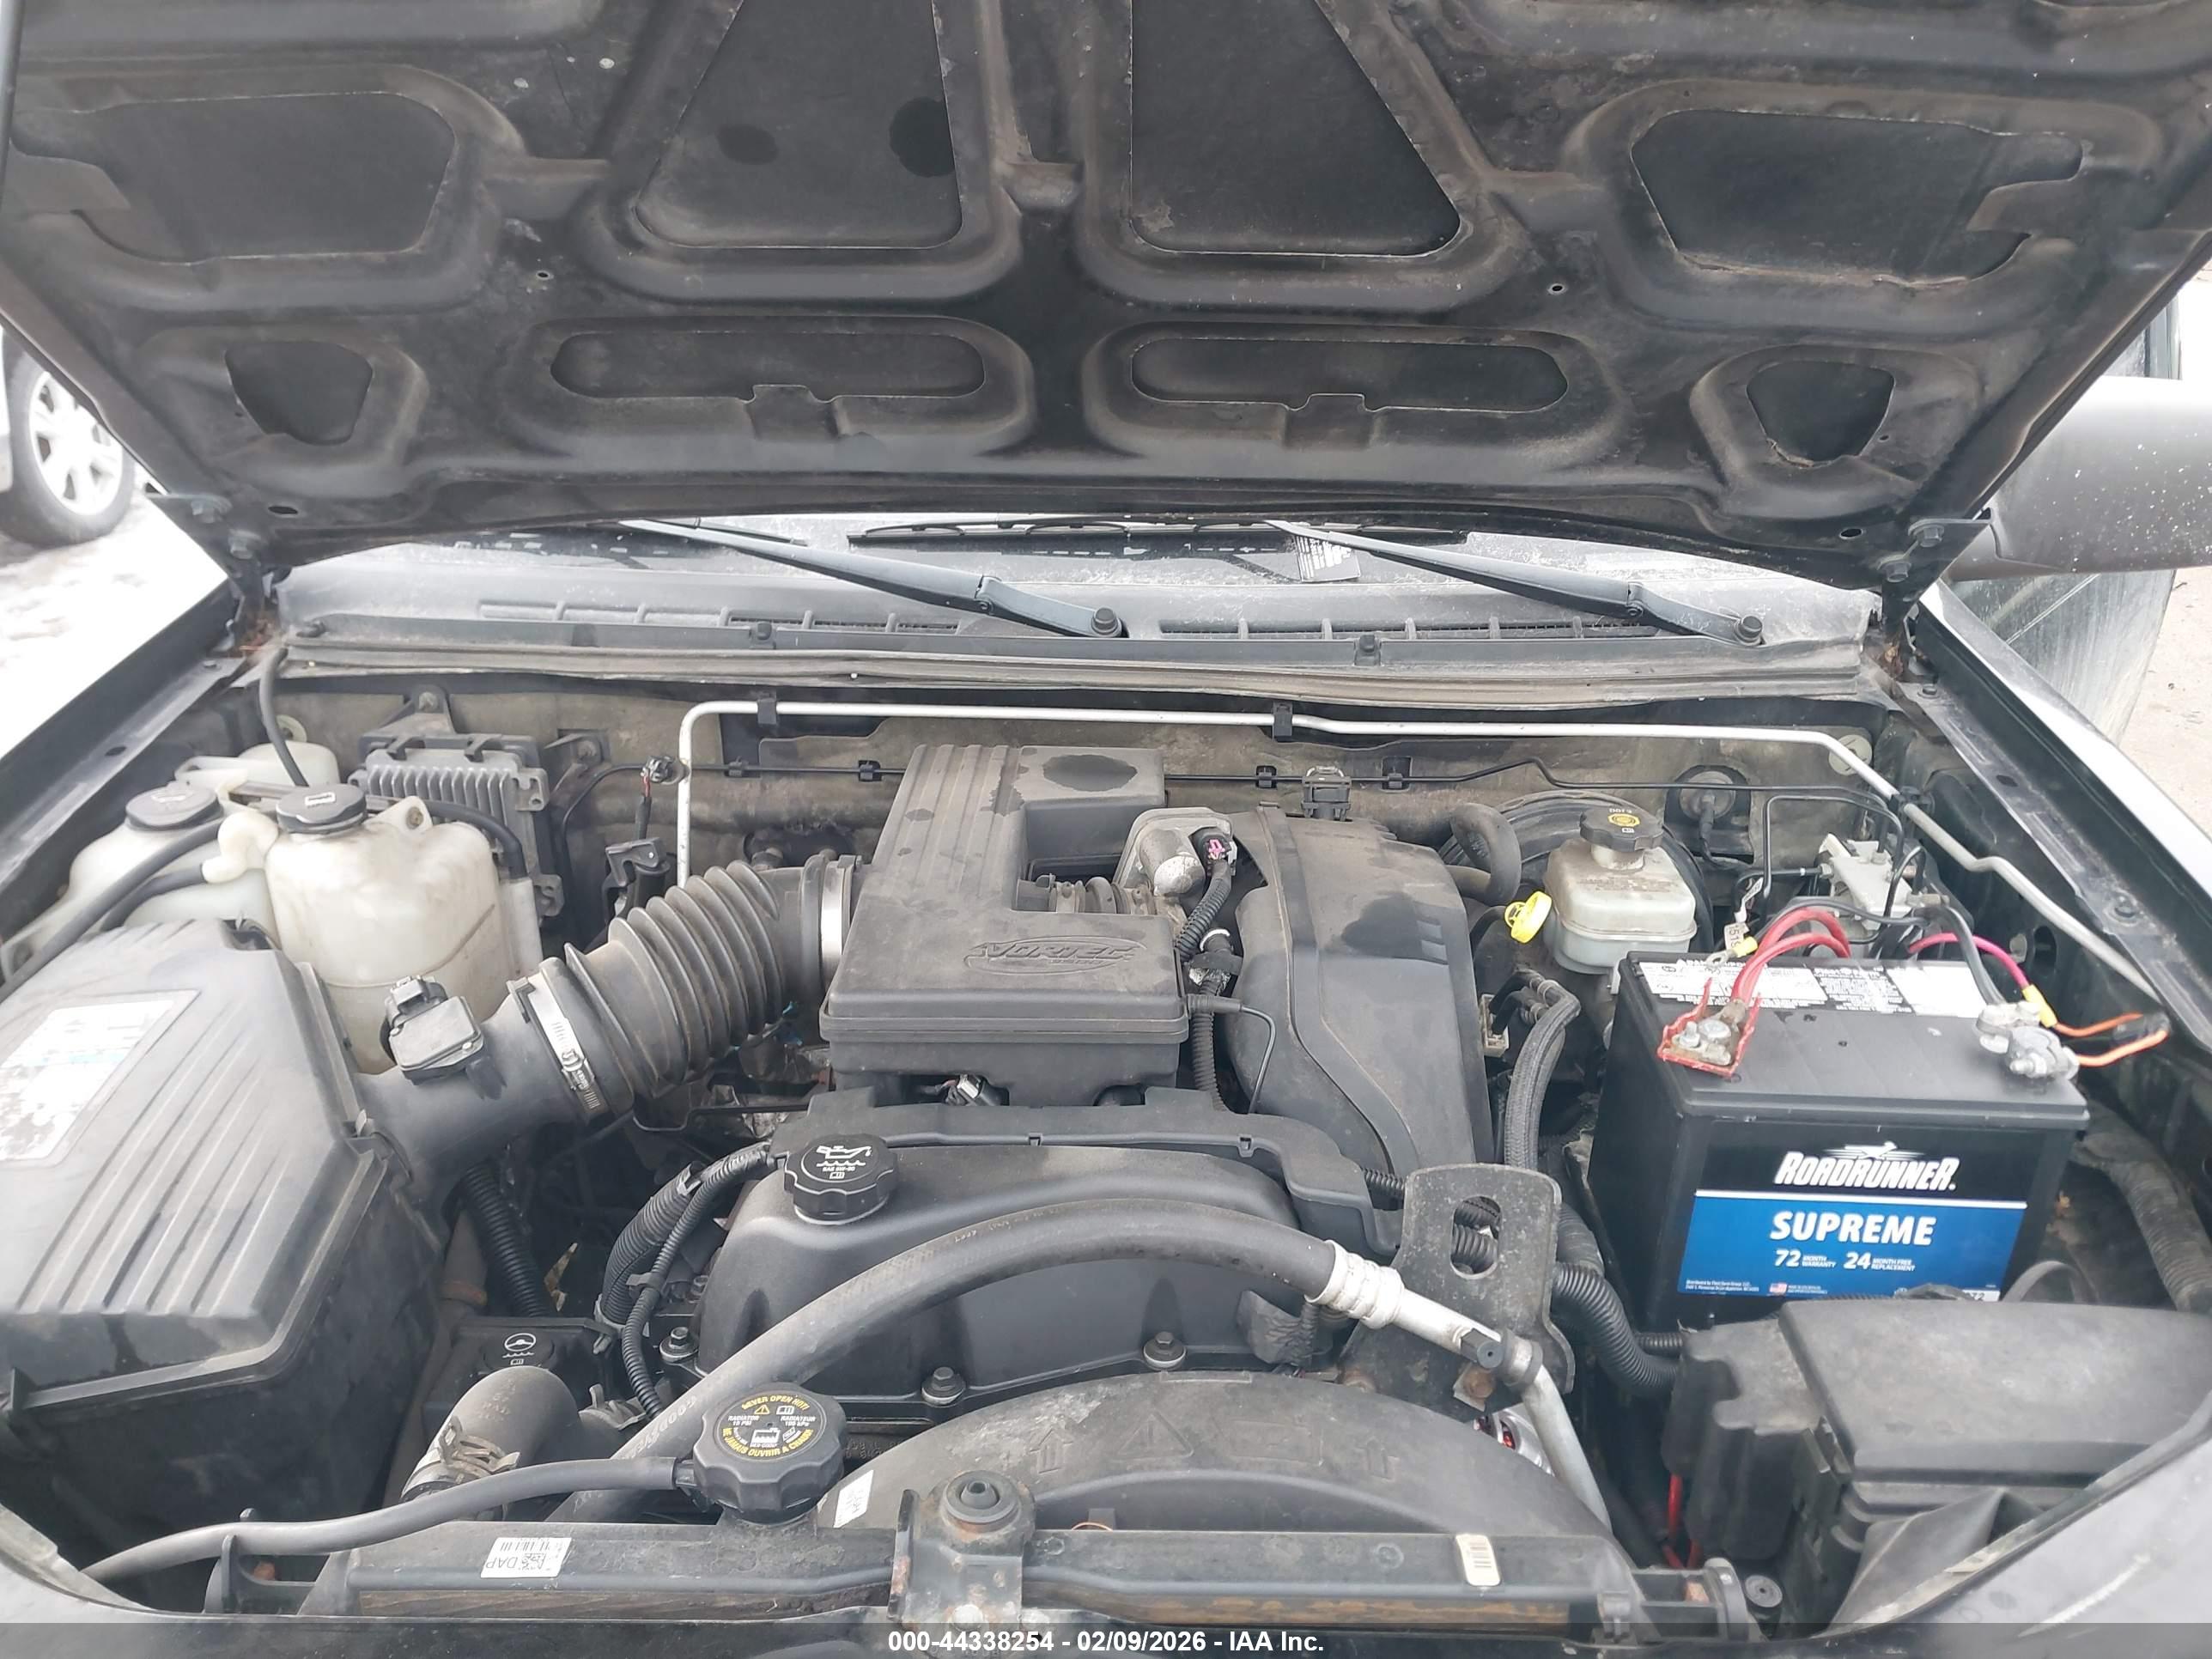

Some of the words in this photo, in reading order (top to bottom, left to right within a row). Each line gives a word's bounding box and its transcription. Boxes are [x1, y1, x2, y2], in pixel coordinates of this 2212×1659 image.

[983, 944, 1133, 960] VORTEC
[1769, 1211, 1937, 1245] SUPREME
[1775, 1249, 1802, 1267] 72
[1844, 1251, 1872, 1270] 24
[1871, 1263, 1915, 1272] REPLACEMENT
[741, 1396, 769, 1410] NEVER
[792, 1399, 810, 1411] HOT!
[722, 1427, 732, 1437] NE
[724, 1436, 749, 1455] JAMAIS
[747, 1448, 781, 1457] OUVRIR
[485, 1556, 518, 1569] DAP
